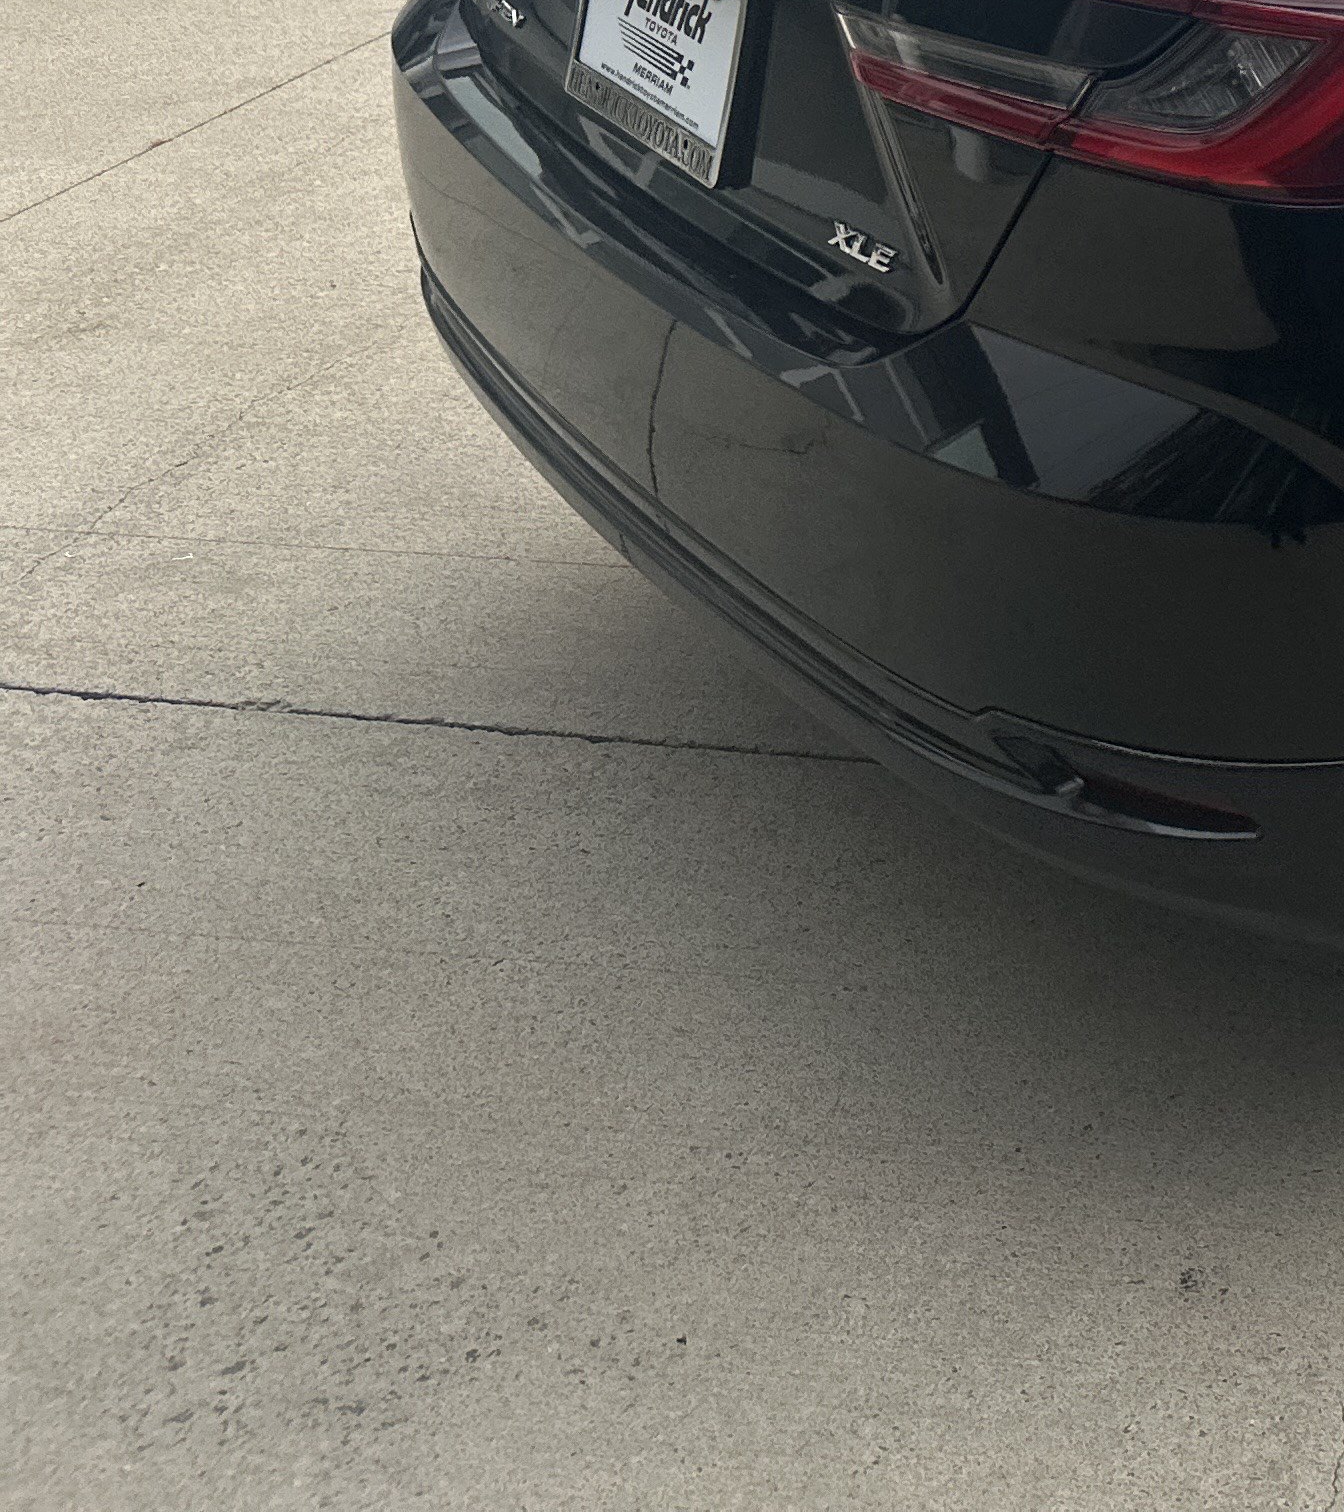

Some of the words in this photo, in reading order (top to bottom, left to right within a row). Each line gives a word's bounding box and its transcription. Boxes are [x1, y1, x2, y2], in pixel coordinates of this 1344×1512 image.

[644, 17, 678, 46] TOYOTA
[632, 61, 674, 96] MERRIAM
[827, 220, 899, 274] XLE
